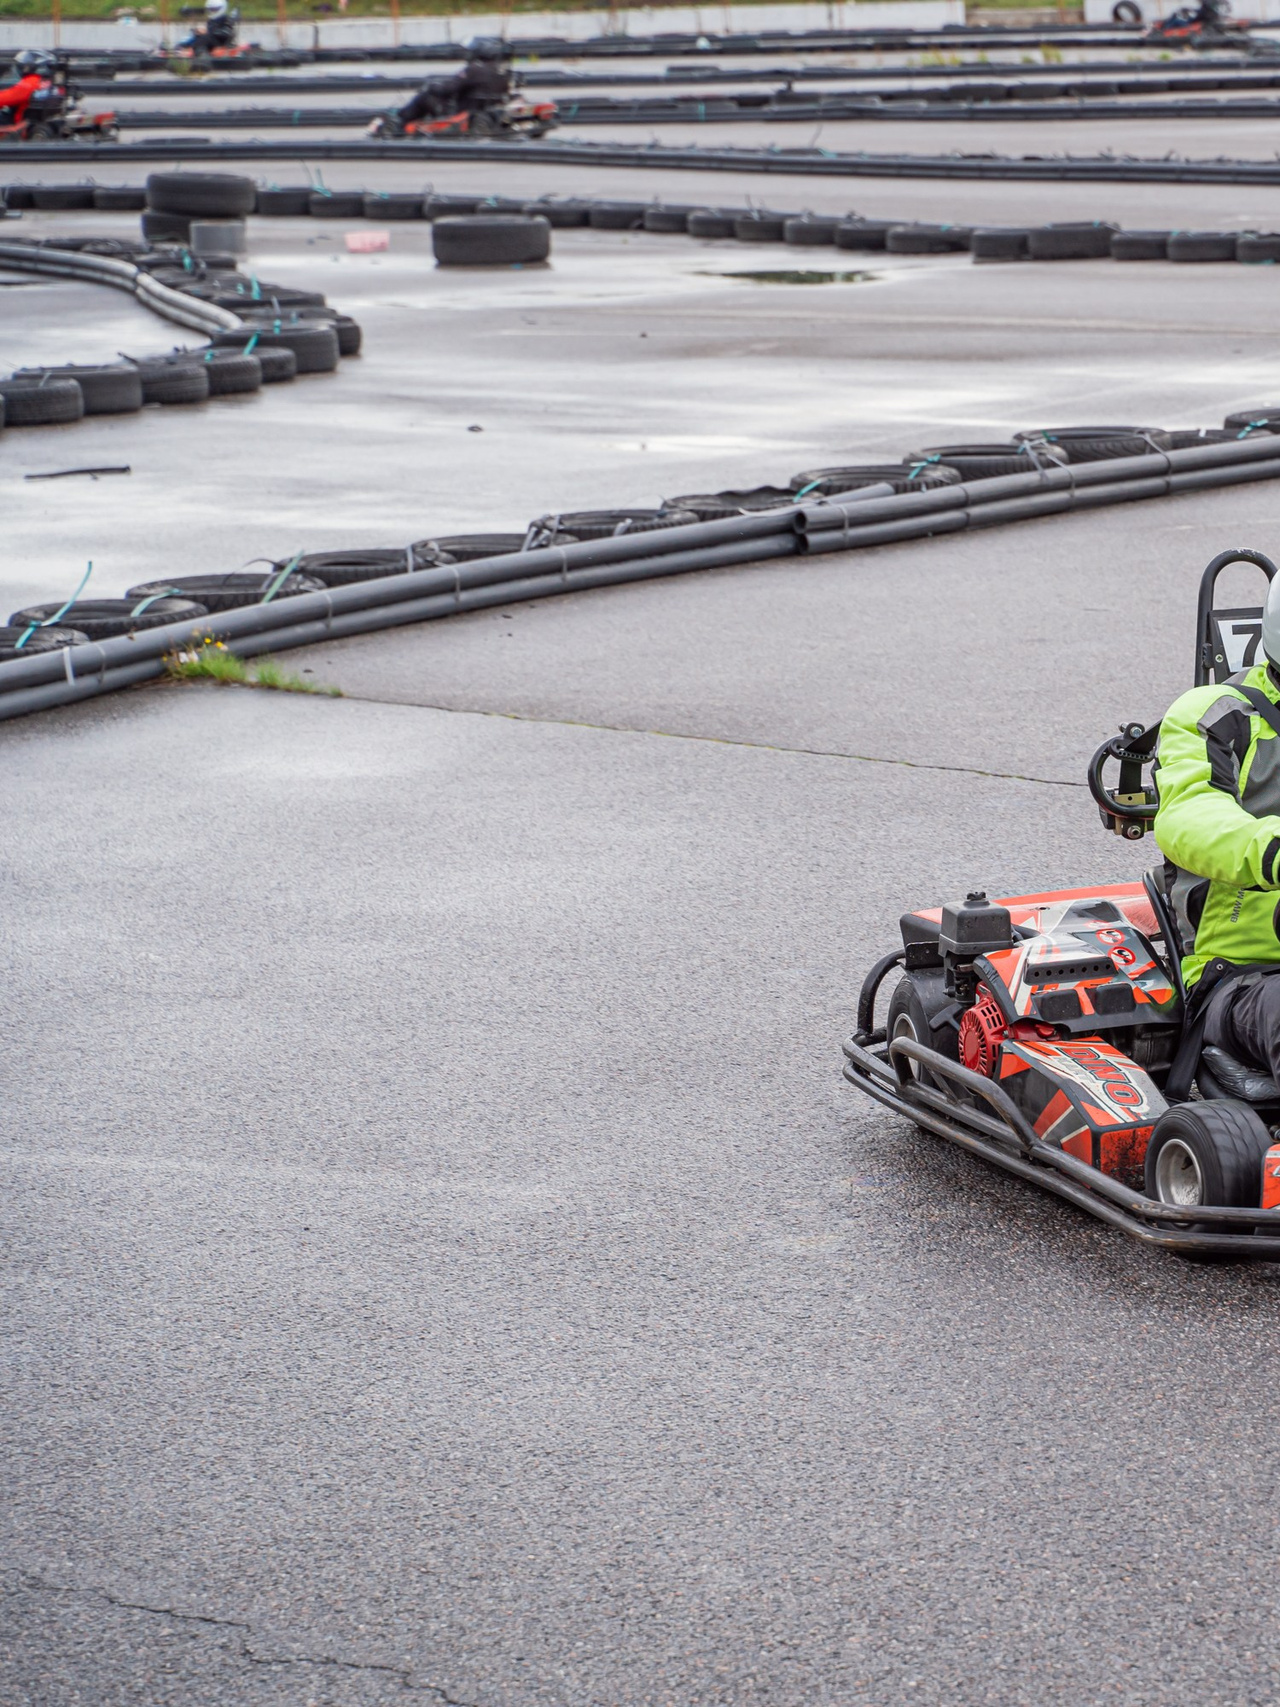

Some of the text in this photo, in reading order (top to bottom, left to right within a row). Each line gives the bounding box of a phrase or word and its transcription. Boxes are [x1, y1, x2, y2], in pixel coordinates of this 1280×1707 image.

[1231, 624, 1263, 667] 7
[1230, 900, 1242, 923] BMW
[1055, 1047, 1143, 1106] DINO
